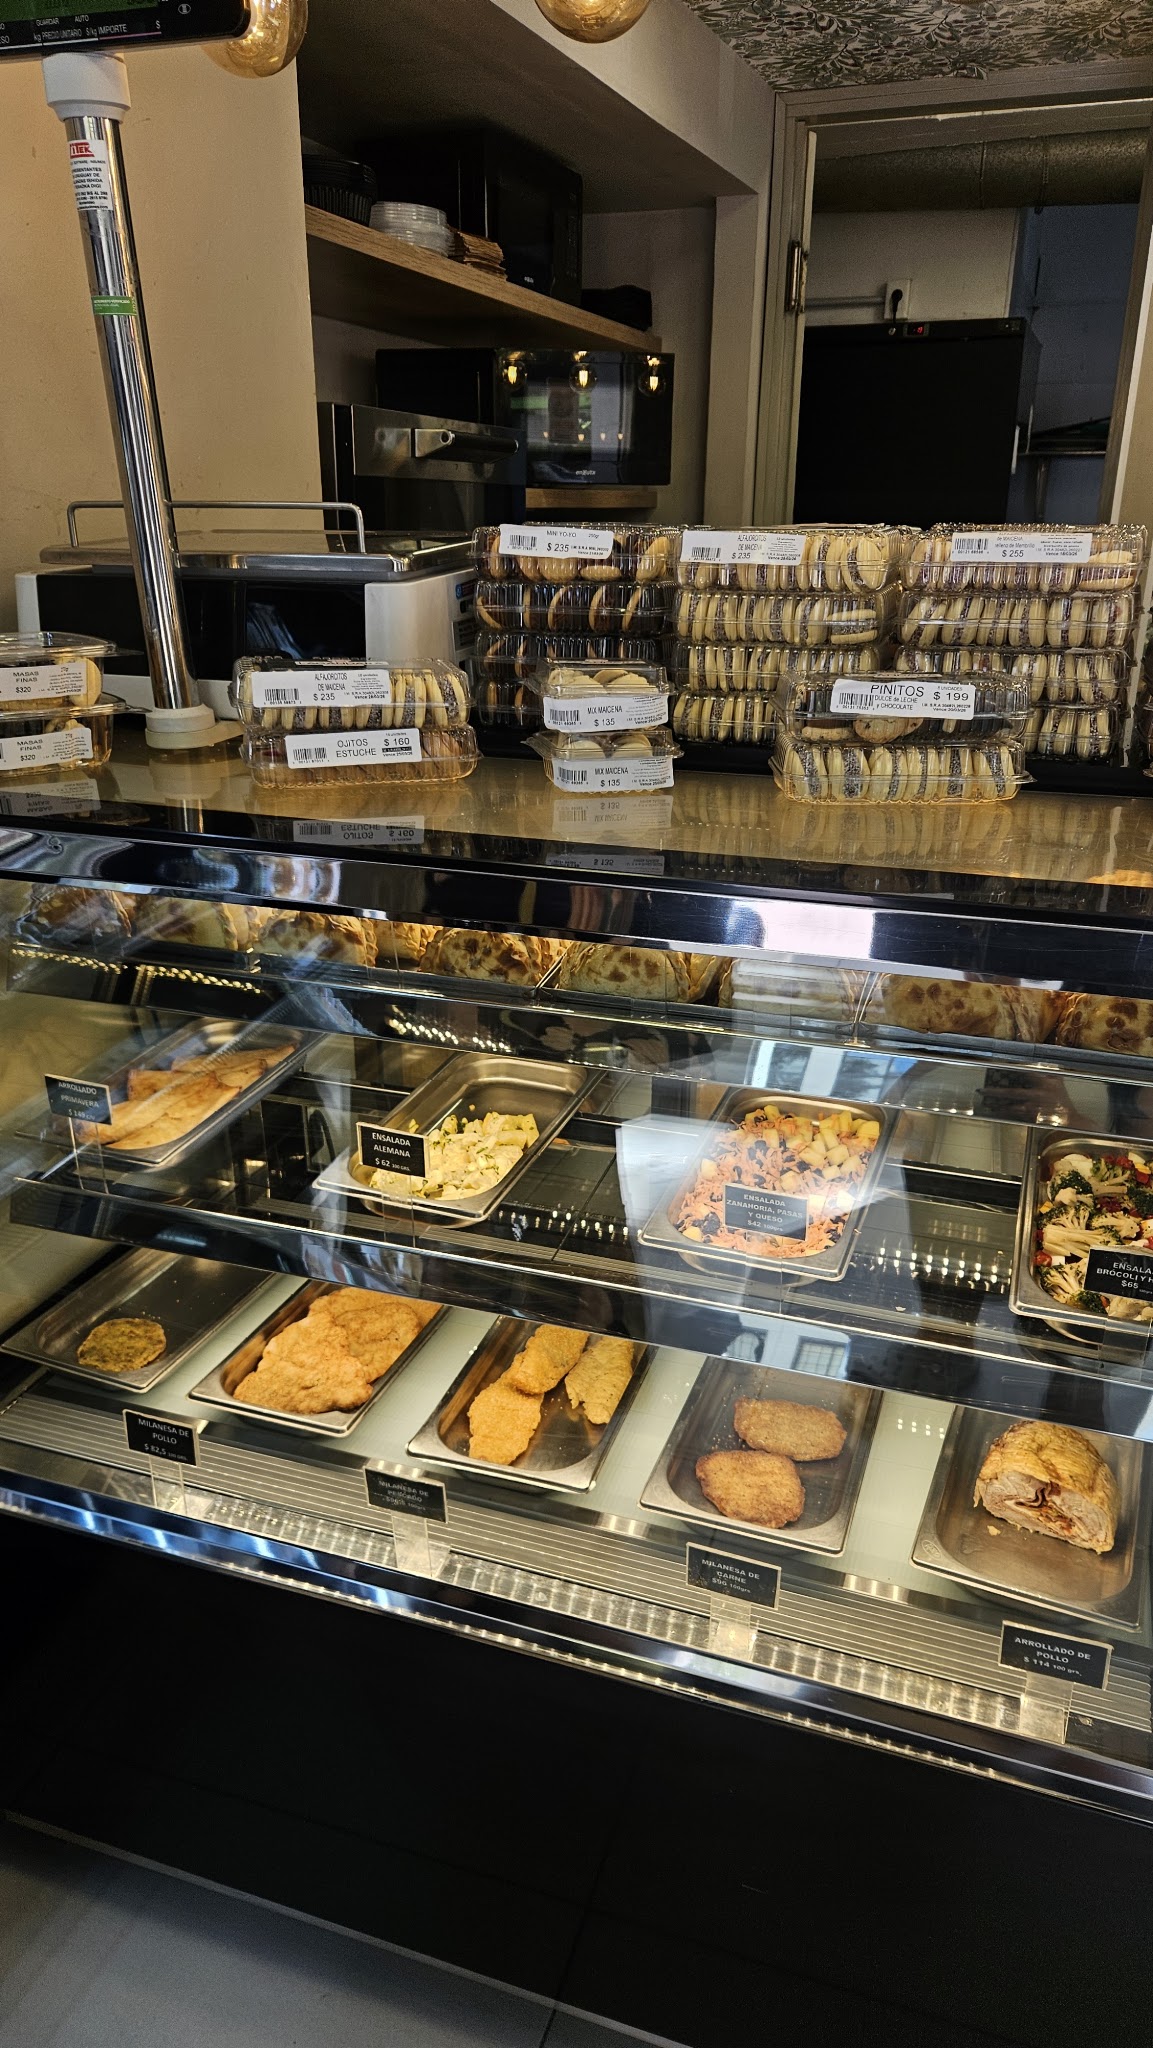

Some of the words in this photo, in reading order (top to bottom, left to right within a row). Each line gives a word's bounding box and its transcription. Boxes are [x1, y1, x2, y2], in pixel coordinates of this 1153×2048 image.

[98, 24, 127, 34] IMPORTE
[547, 543, 552, 552] $
[554, 543, 569, 553] 235
[1002, 550, 1007, 558] $
[318, 683, 324, 691] DE
[325, 683, 346, 691] MAICENA
[870, 684, 925, 697] PINITOS
[313, 693, 318, 701] $
[321, 693, 335, 701] 235
[933, 691, 941, 701] $
[947, 692, 968, 701] 199
[587, 707, 597, 715] MIX
[598, 705, 623, 713] MAICENA
[602, 718, 615, 726] 135
[337, 738, 368, 748] OJITOS
[384, 739, 389, 747] $
[393, 737, 410, 746] 160
[336, 748, 377, 758] ESTUCHE
[595, 767, 604, 775] MIX
[605, 767, 629, 775] MAICENA
[58, 1081, 97, 1095] ARROLLADO
[61, 1095, 99, 1107] PRIMAVERA
[372, 1132, 411, 1146] ENSALADA
[374, 1144, 411, 1158] ALEMANA
[375, 1157, 380, 1165] $
[381, 1159, 390, 1167] 62
[743, 1194, 786, 1206] ENSALADA
[726, 1199, 775, 1214] ZANAHORIA,
[777, 1208, 803, 1218] PASAS
[755, 1213, 783, 1223] QUESO
[747, 1220, 761, 1228] $42
[1113, 1262, 1153, 1275] ENSALA
[1121, 1280, 1139, 1289] $65
[138, 1418, 177, 1434] MILANESA
[179, 1429, 189, 1437] DE
[152, 1432, 177, 1445] POLLO
[144, 1443, 149, 1451] $
[379, 1480, 417, 1493] MILANESA
[419, 1489, 429, 1497] DE
[702, 1559, 746, 1576] MILANESA
[716, 1571, 746, 1584] CARNE
[1015, 1637, 1075, 1656] ARROLLADO
[1077, 1651, 1091, 1660] DE
[1033, 1658, 1049, 1667] 114
[1036, 1651, 1069, 1664] POLLO
